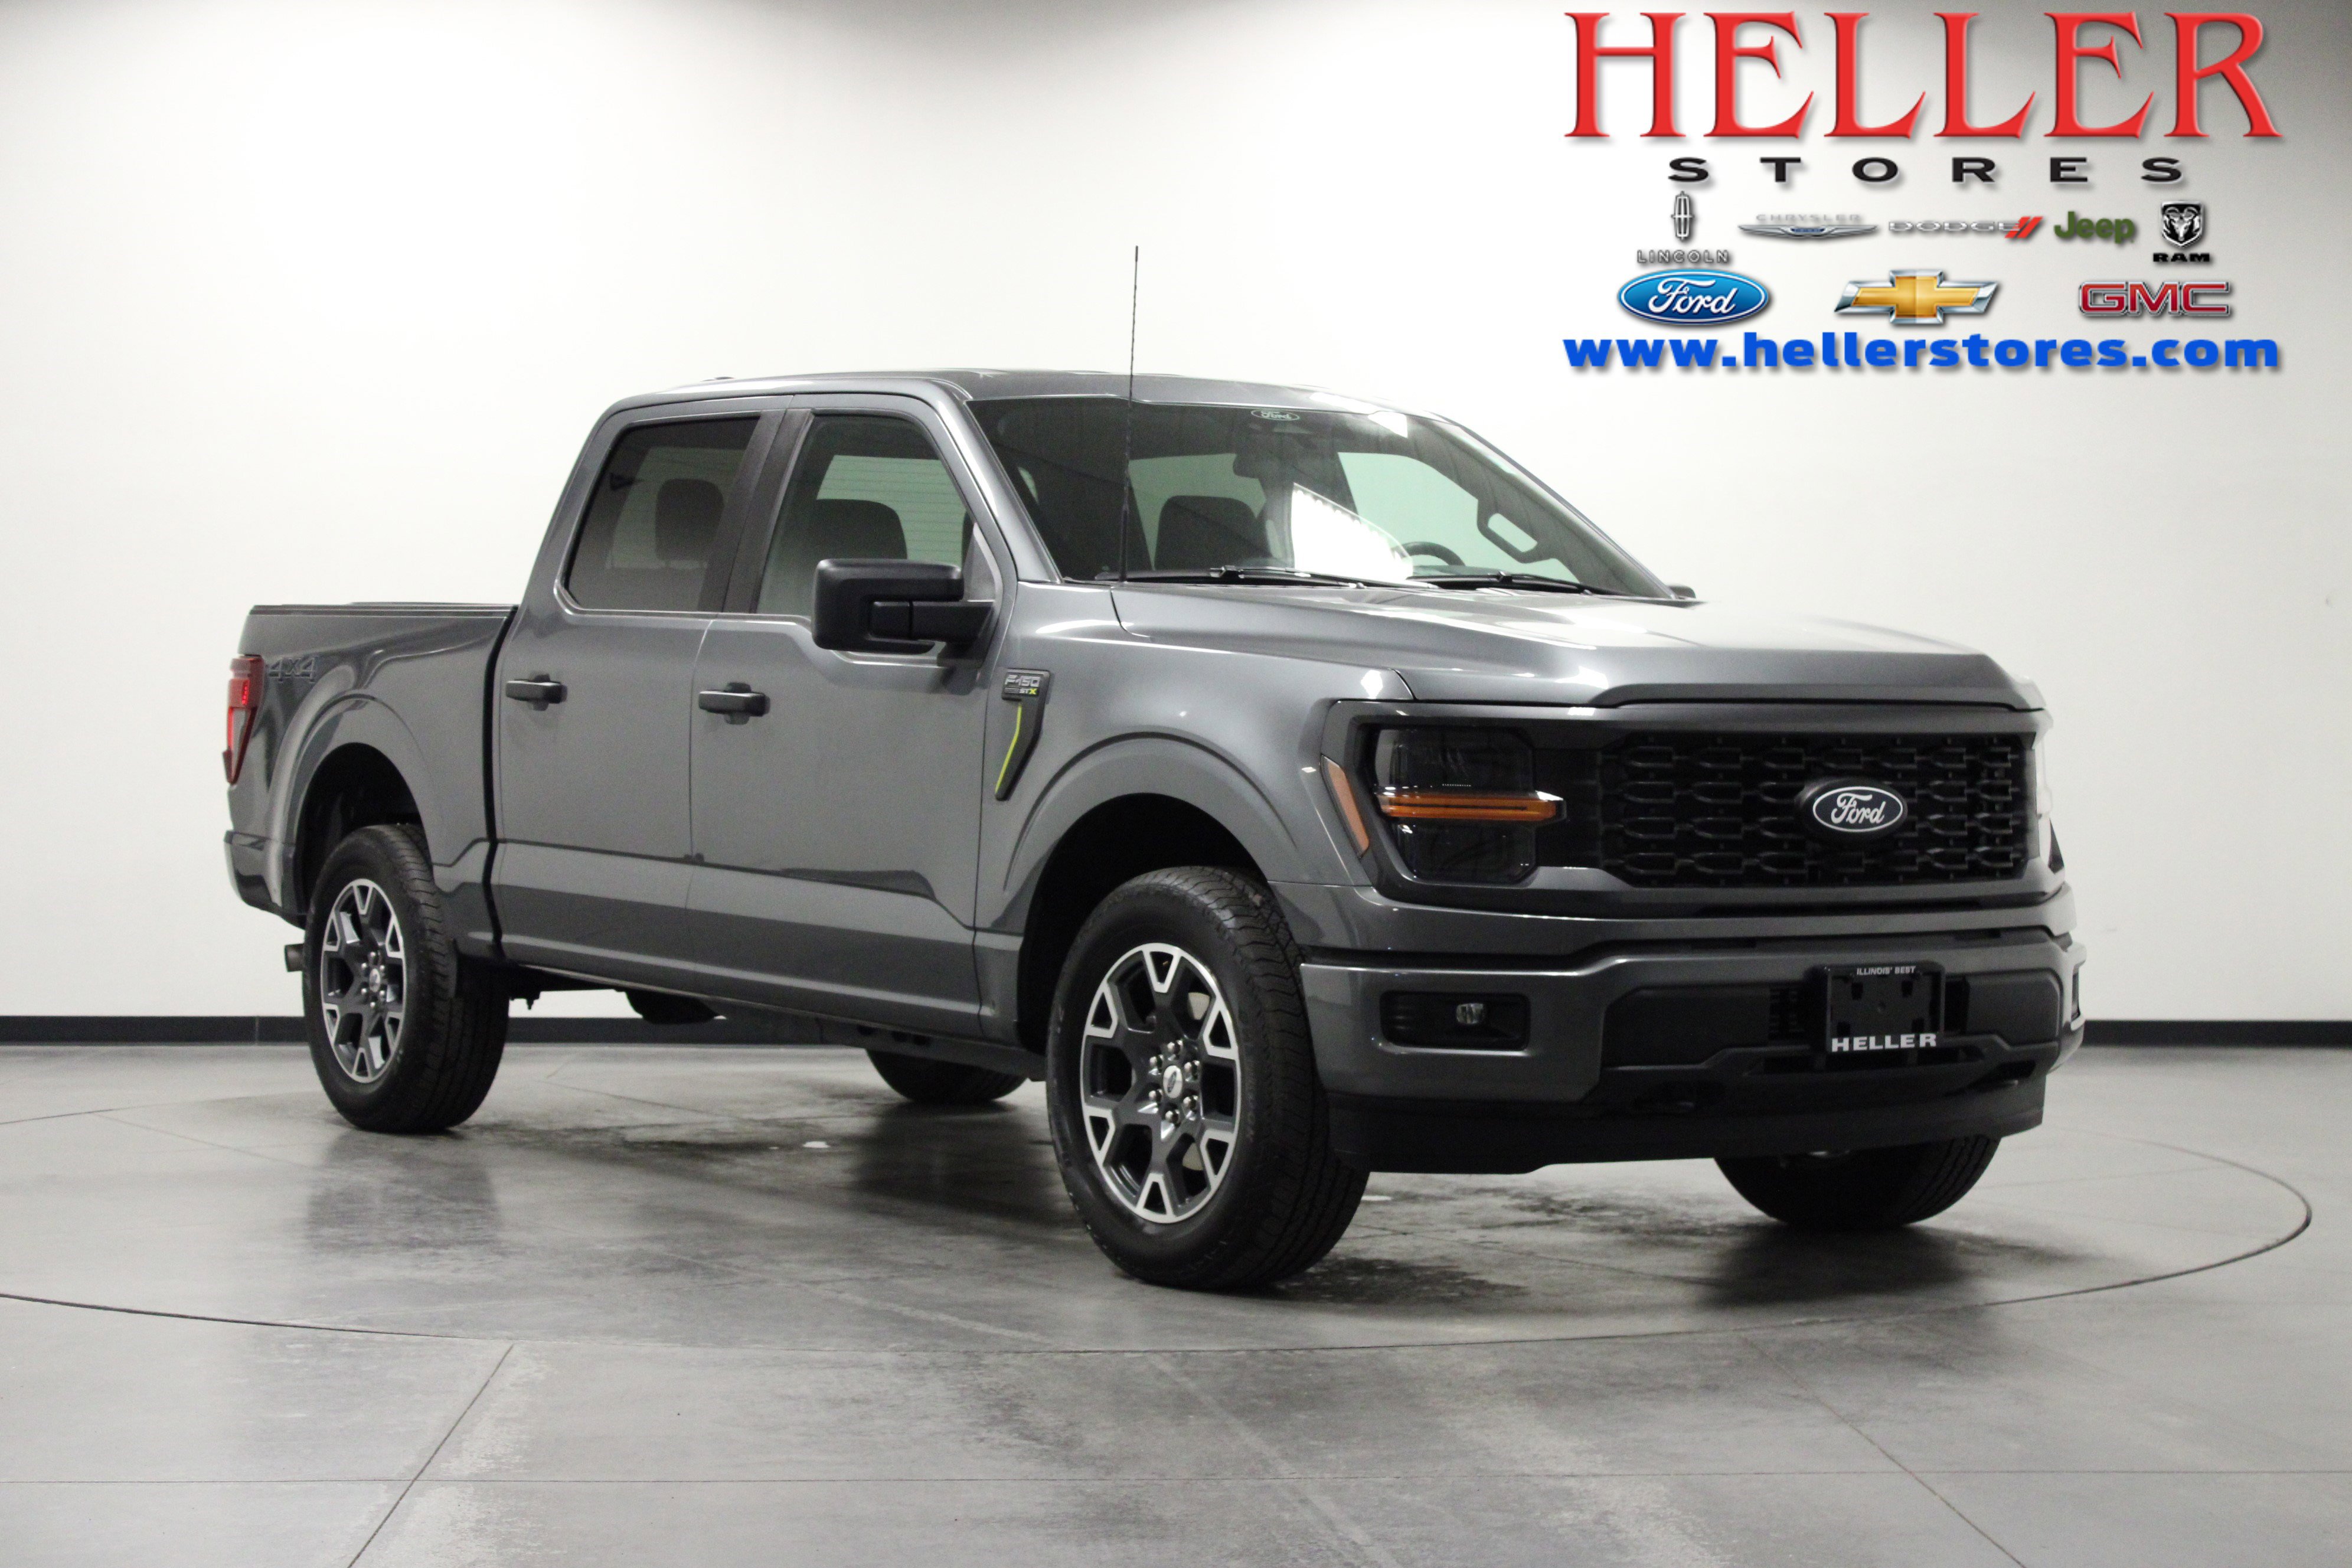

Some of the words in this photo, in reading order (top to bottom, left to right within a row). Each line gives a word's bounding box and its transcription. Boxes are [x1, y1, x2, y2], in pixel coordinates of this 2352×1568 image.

[1004, 674, 1040, 687] F-150
[1831, 792, 1886, 824] Ford
[1894, 965, 1916, 974] BEST
[1831, 1033, 1937, 1053] HELLER
